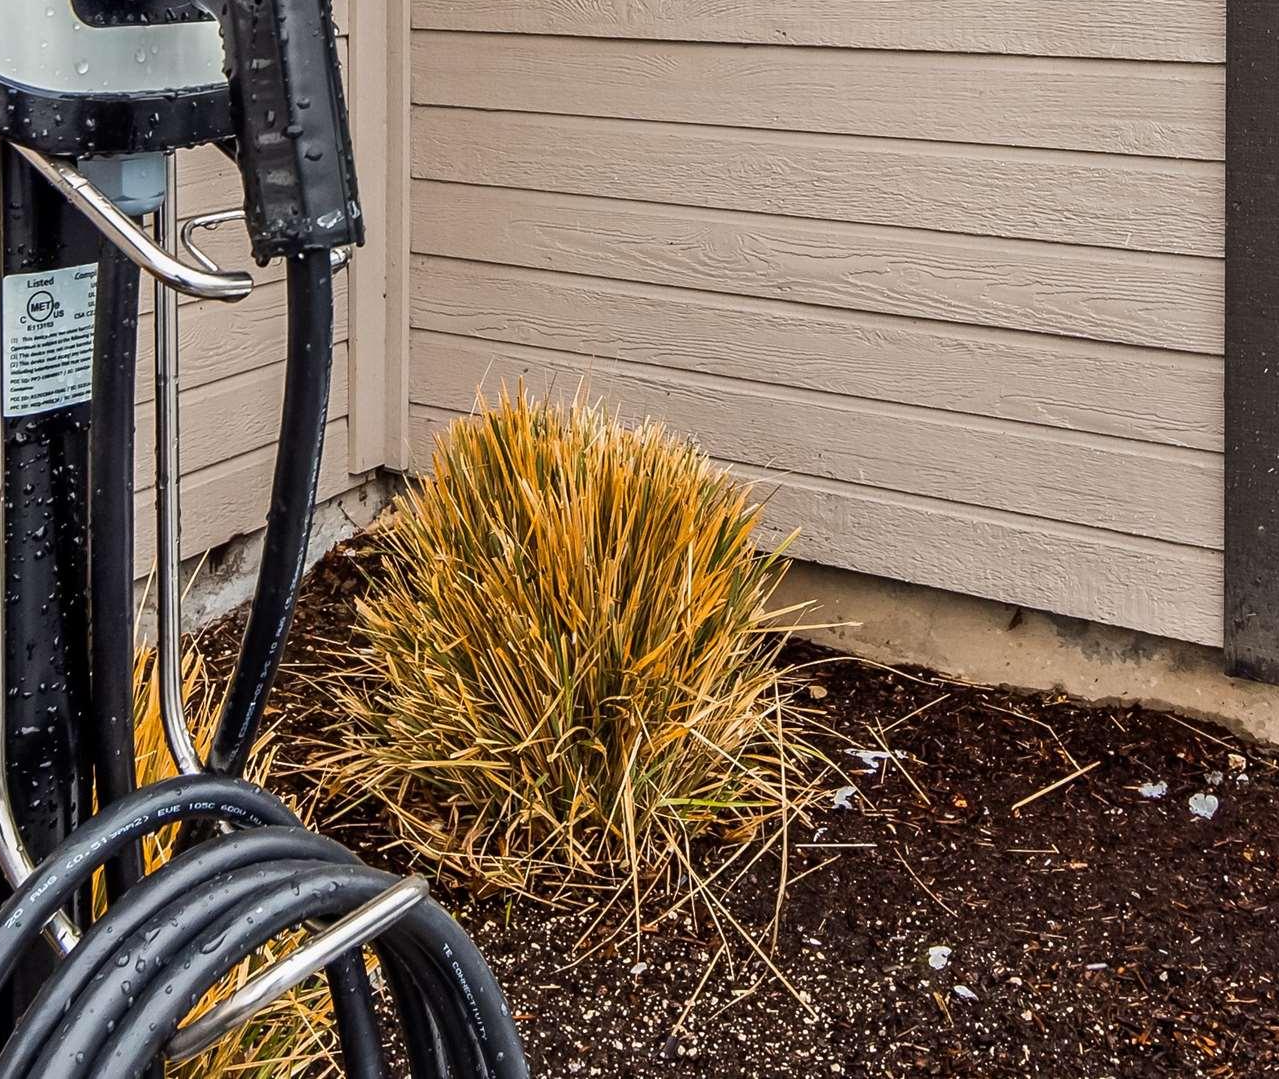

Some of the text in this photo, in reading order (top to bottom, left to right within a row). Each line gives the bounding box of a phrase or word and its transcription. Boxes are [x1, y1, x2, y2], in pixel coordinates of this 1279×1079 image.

[27, 277, 55, 288] Listed
[31, 301, 52, 312] MET
[53, 310, 64, 319] US
[4, 908, 24, 928] 20
[30, 875, 58, 902] AWG
[189, 802, 216, 811] 105C
[442, 943, 453, 959] TE
